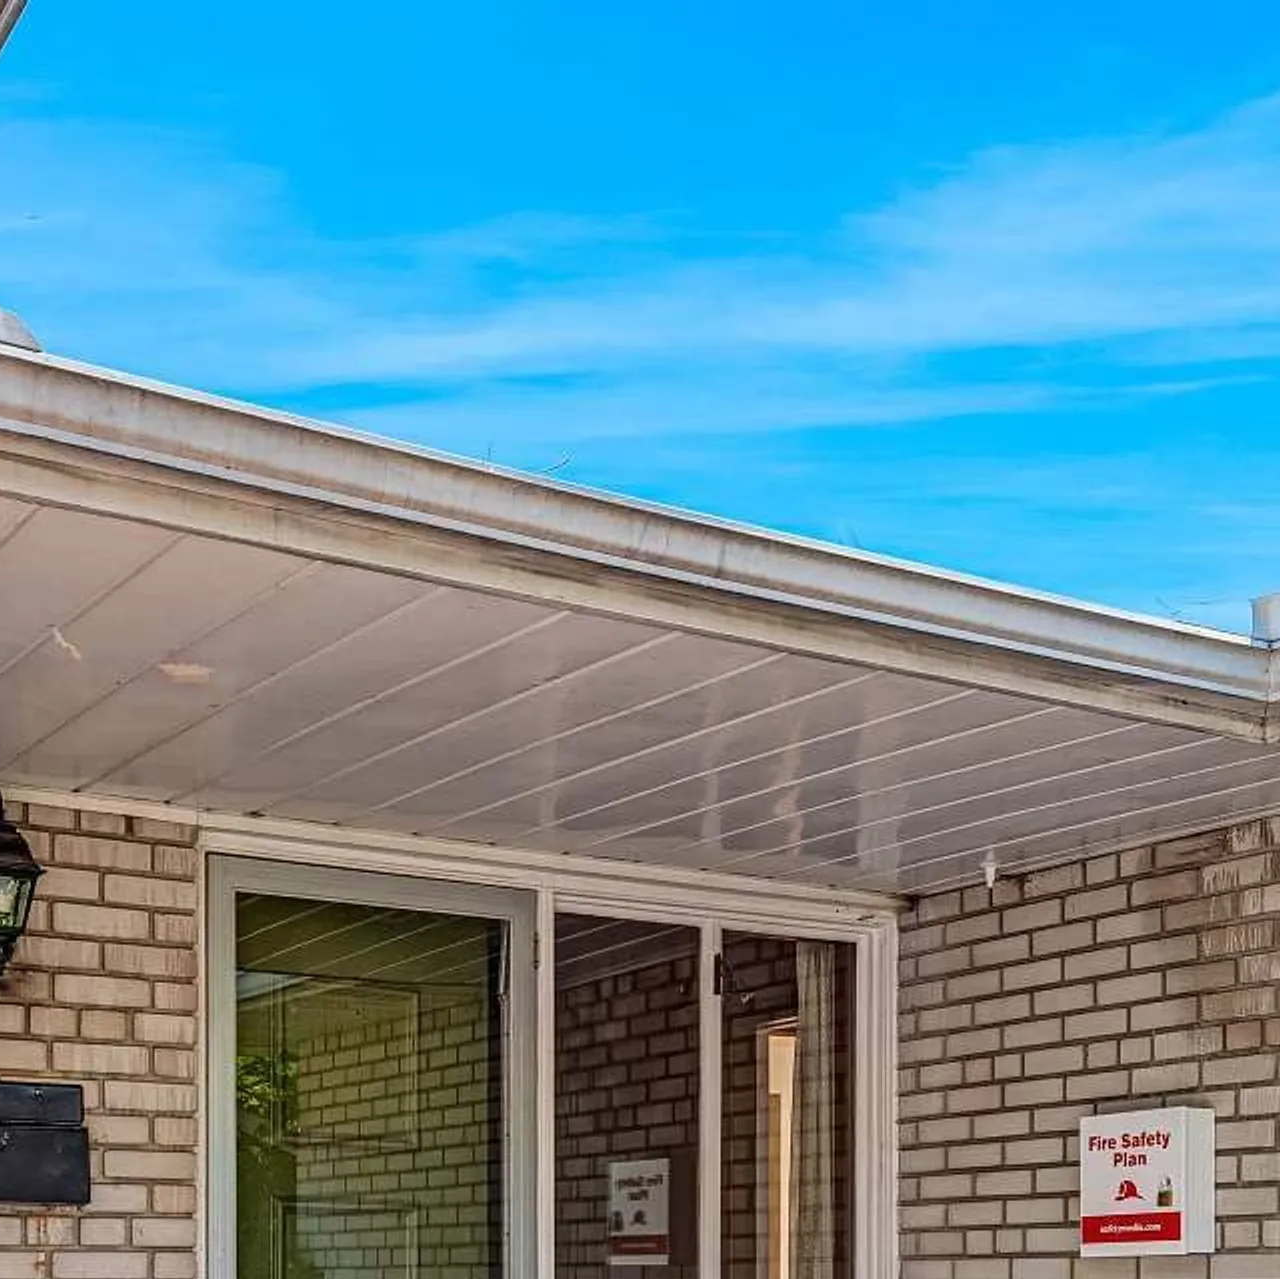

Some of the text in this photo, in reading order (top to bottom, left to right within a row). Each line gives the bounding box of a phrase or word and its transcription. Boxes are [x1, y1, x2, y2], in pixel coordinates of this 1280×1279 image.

[1088, 1131, 1171, 1151] Fire Safety
[1113, 1152, 1147, 1167] Plan
